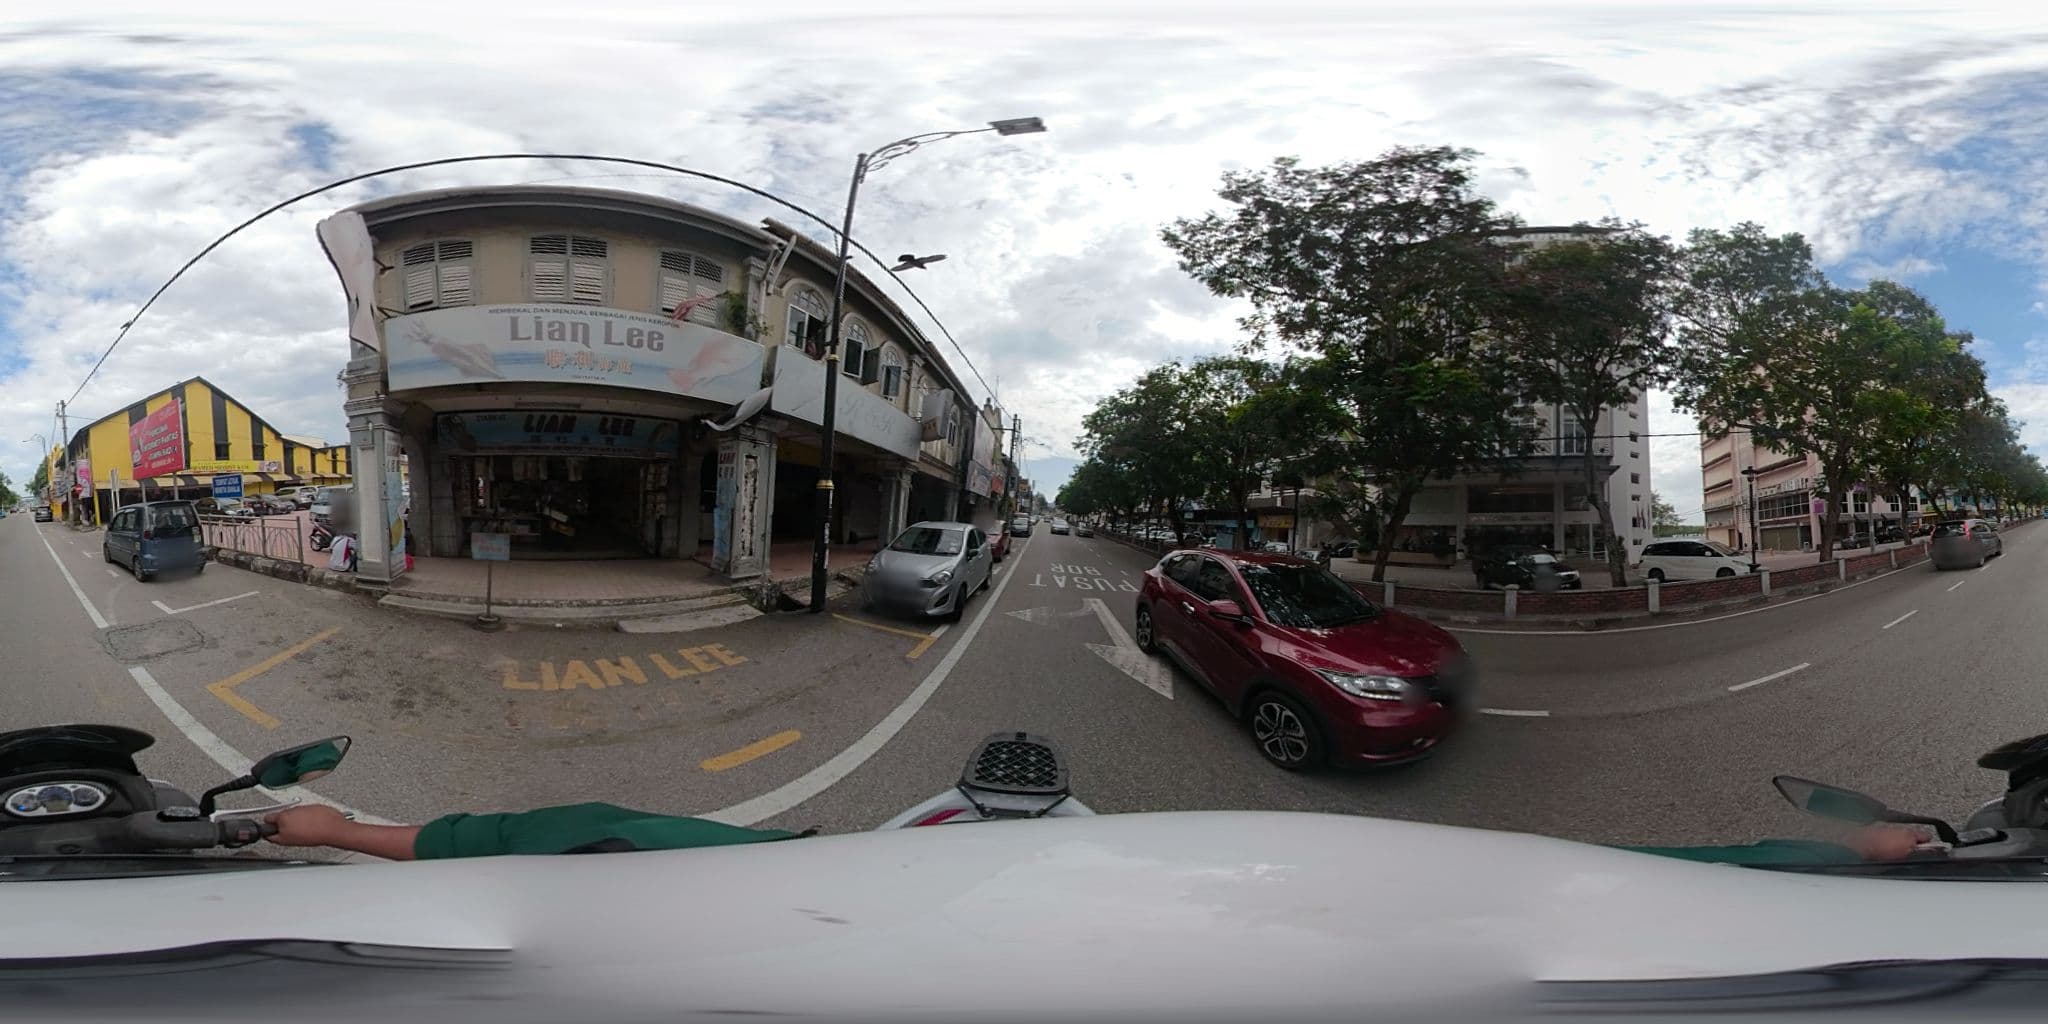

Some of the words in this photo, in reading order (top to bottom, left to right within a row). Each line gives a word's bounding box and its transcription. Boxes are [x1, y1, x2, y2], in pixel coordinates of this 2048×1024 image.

[510, 316, 592, 349] Lian
[604, 320, 664, 352] Lee
[523, 414, 577, 432] LIAN
[599, 416, 636, 436] LEE
[1028, 573, 1140, 592] PUSAT
[499, 656, 648, 691] LIAN
[649, 643, 748, 680] LEE
